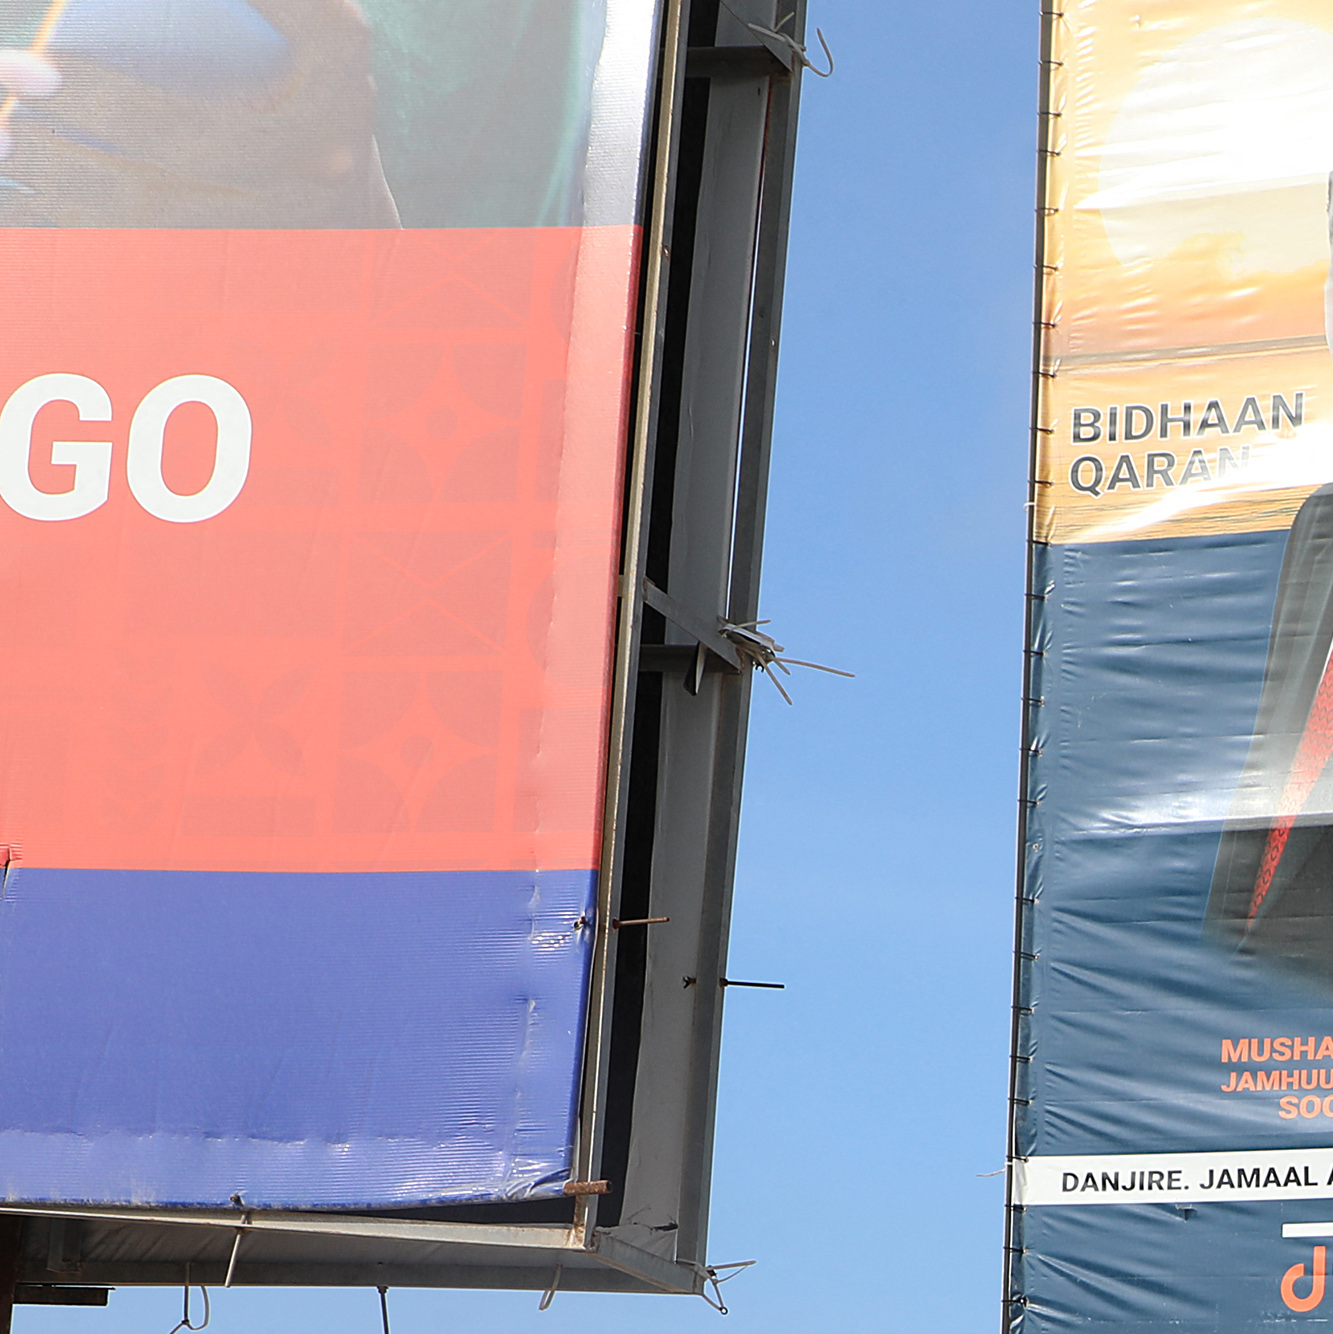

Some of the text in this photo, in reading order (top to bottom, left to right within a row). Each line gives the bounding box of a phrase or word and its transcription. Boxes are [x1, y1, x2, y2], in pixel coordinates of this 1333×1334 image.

[1072, 392, 1304, 443] BIDHAAN
[0, 372, 253, 523] GO
[1061, 1170, 1190, 1193] DANJIRE.
[1199, 1165, 1318, 1190] JAMAAL
